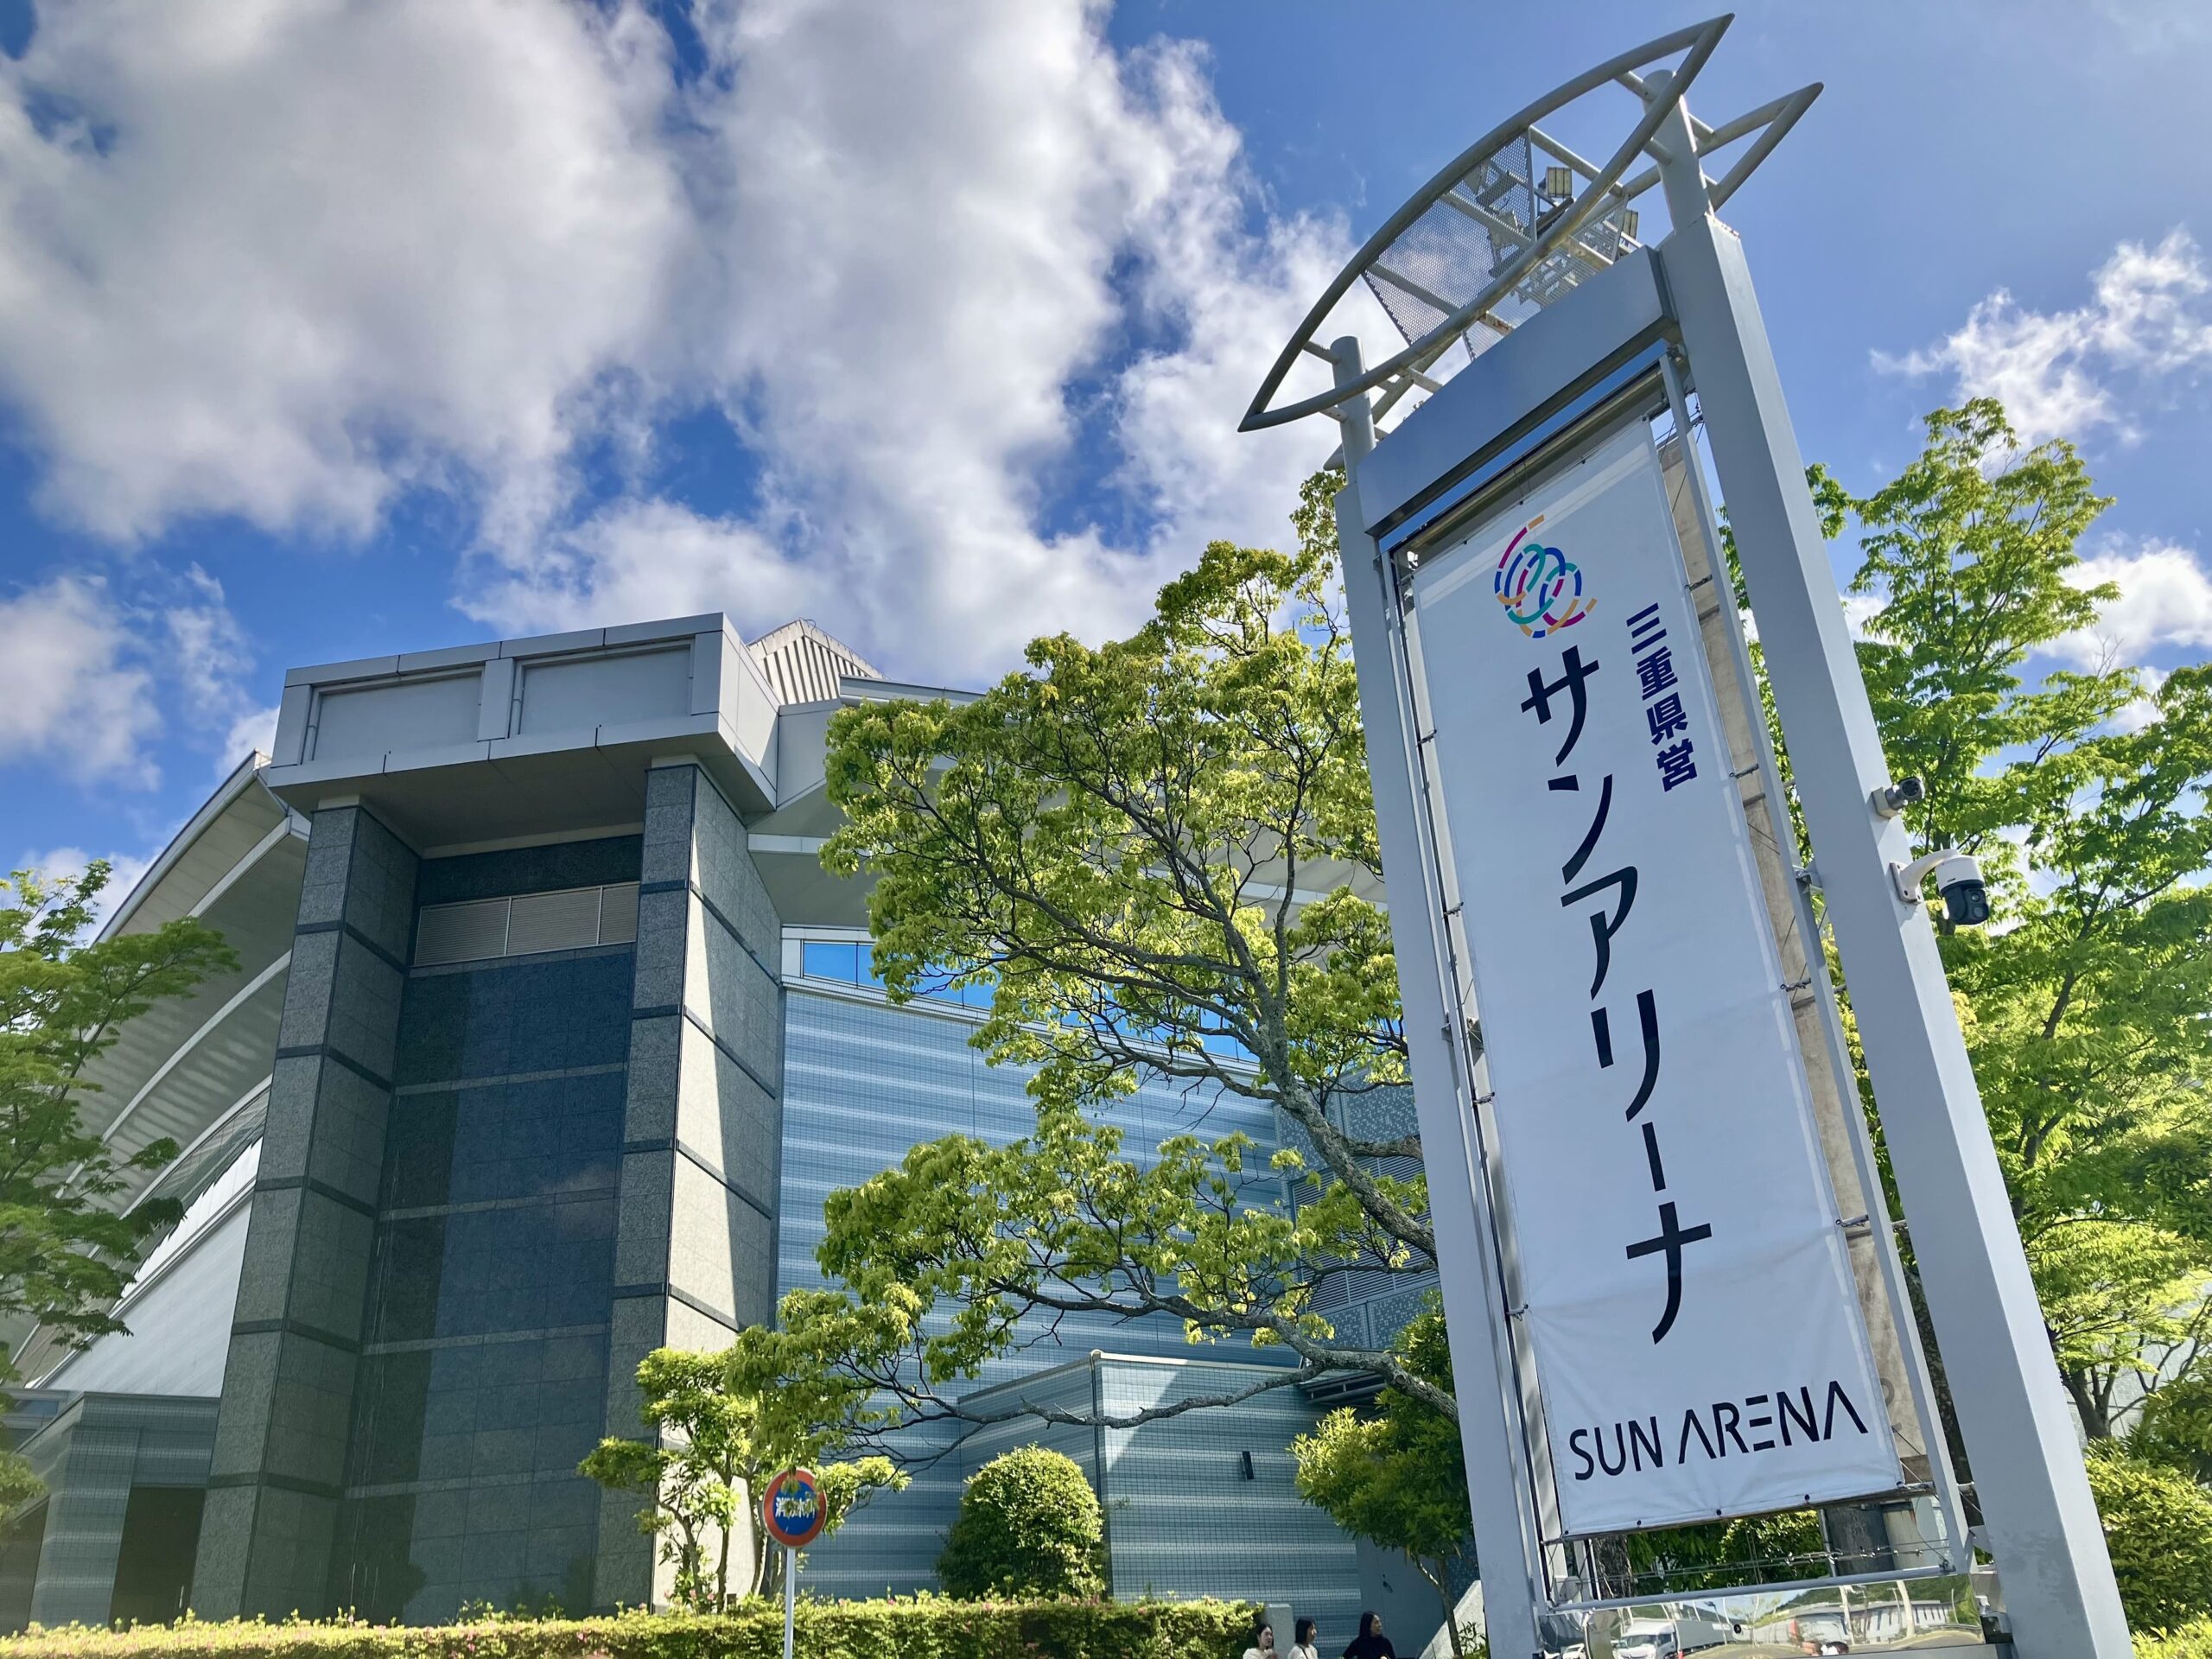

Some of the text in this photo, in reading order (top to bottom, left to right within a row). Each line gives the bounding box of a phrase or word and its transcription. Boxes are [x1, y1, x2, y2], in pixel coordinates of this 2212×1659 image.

[1626, 603, 1698, 792] 三重県営
[1521, 645, 1712, 1344] サンアリーナ
[1569, 1415, 1663, 1481] SUN
[1678, 1380, 1869, 1465] ARENA
